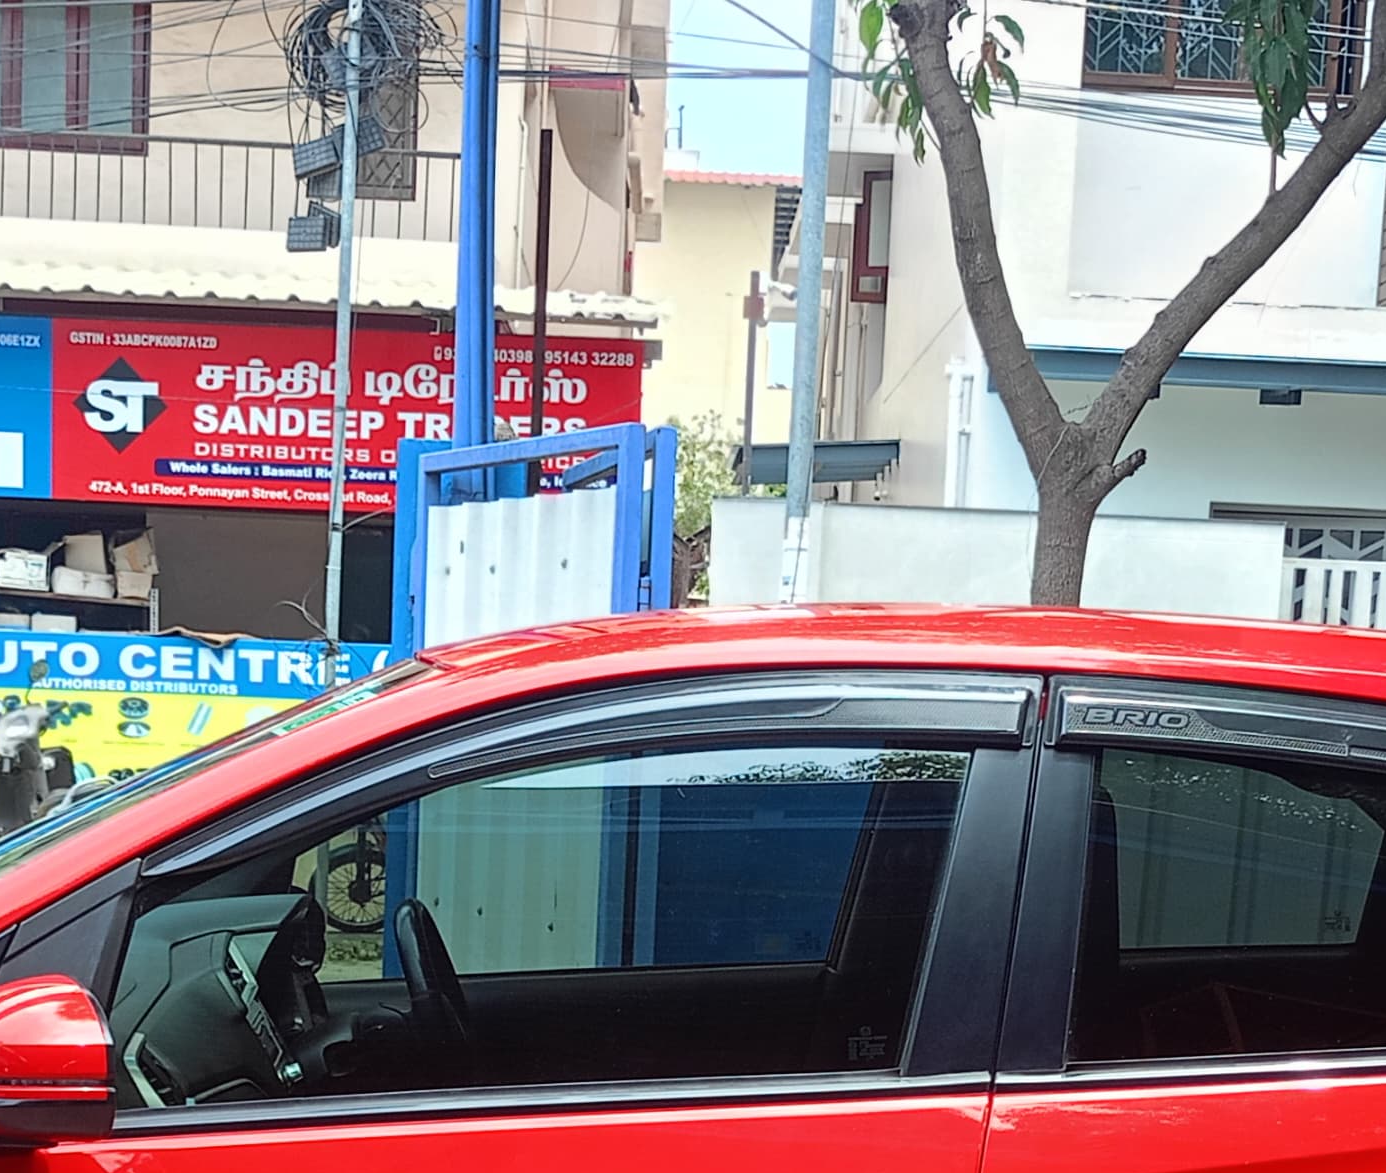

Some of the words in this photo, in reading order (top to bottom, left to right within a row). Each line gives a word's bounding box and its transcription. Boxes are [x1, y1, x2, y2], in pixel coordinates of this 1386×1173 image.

[69, 331, 105, 345] GSTIN
[112, 333, 217, 349] 33ABCPK0087A1ZD
[544, 350, 588, 364] 95143
[591, 352, 634, 367] 32288
[83, 378, 160, 434] ST
[193, 403, 384, 440] SANDEEP
[194, 442, 370, 462] DISTRIBUTORS
[170, 461, 208, 474] Whole
[212, 463, 251, 476] Salers
[262, 465, 313, 478] Basmati
[349, 468, 386, 481] Zeera
[131, 481, 150, 494] 1st
[151, 482, 187, 497] Floor,
[188, 484, 249, 499] Ponnayan
[252, 486, 291, 501] Street,
[357, 490, 392, 505] Road,
[119, 643, 351, 687] CENTRE
[32, 678, 126, 692] AUTHORISED
[130, 680, 238, 696] DISTRIBUTORS
[1084, 707, 1192, 729] BRIO
